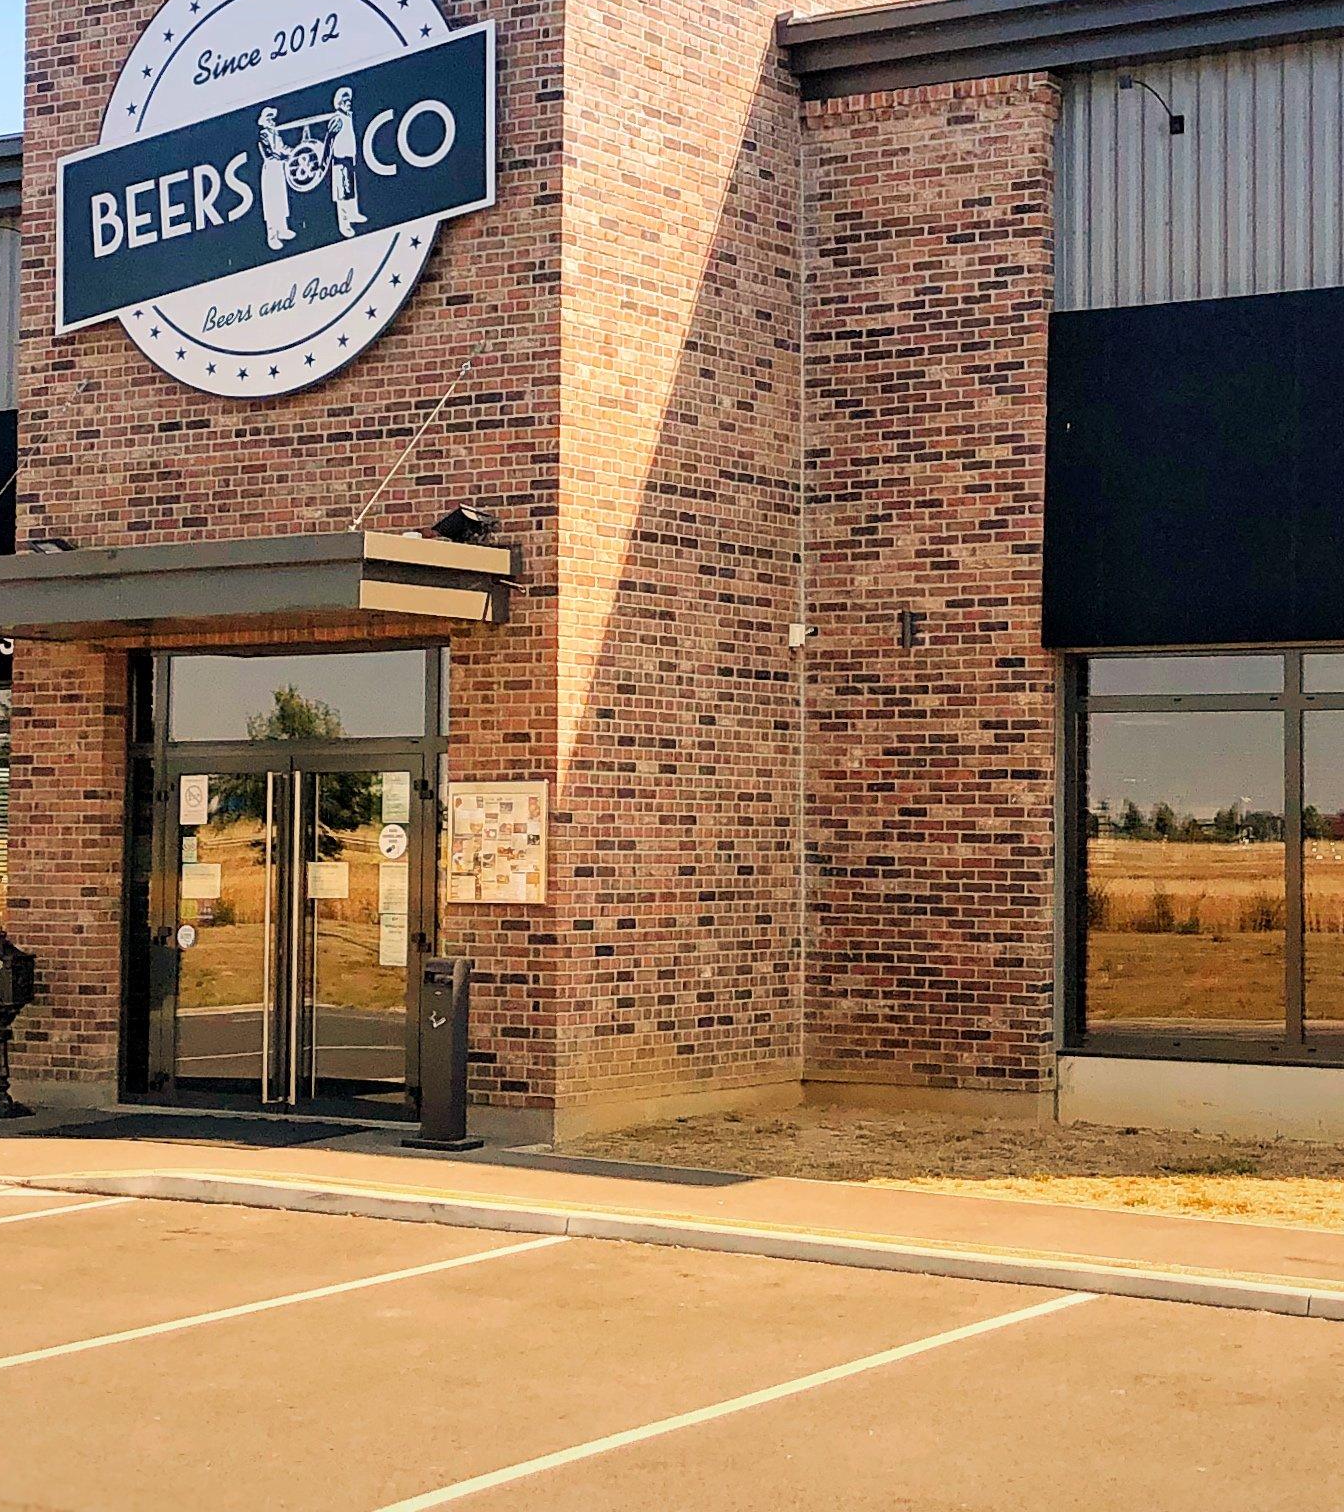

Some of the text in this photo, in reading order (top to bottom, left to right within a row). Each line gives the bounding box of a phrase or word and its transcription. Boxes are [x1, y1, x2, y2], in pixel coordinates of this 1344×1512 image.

[193, 13, 340, 85] Since 2012
[91, 151, 254, 258] BEERS
[362, 99, 456, 176] CO
[202, 267, 354, 333] Beers and Food
